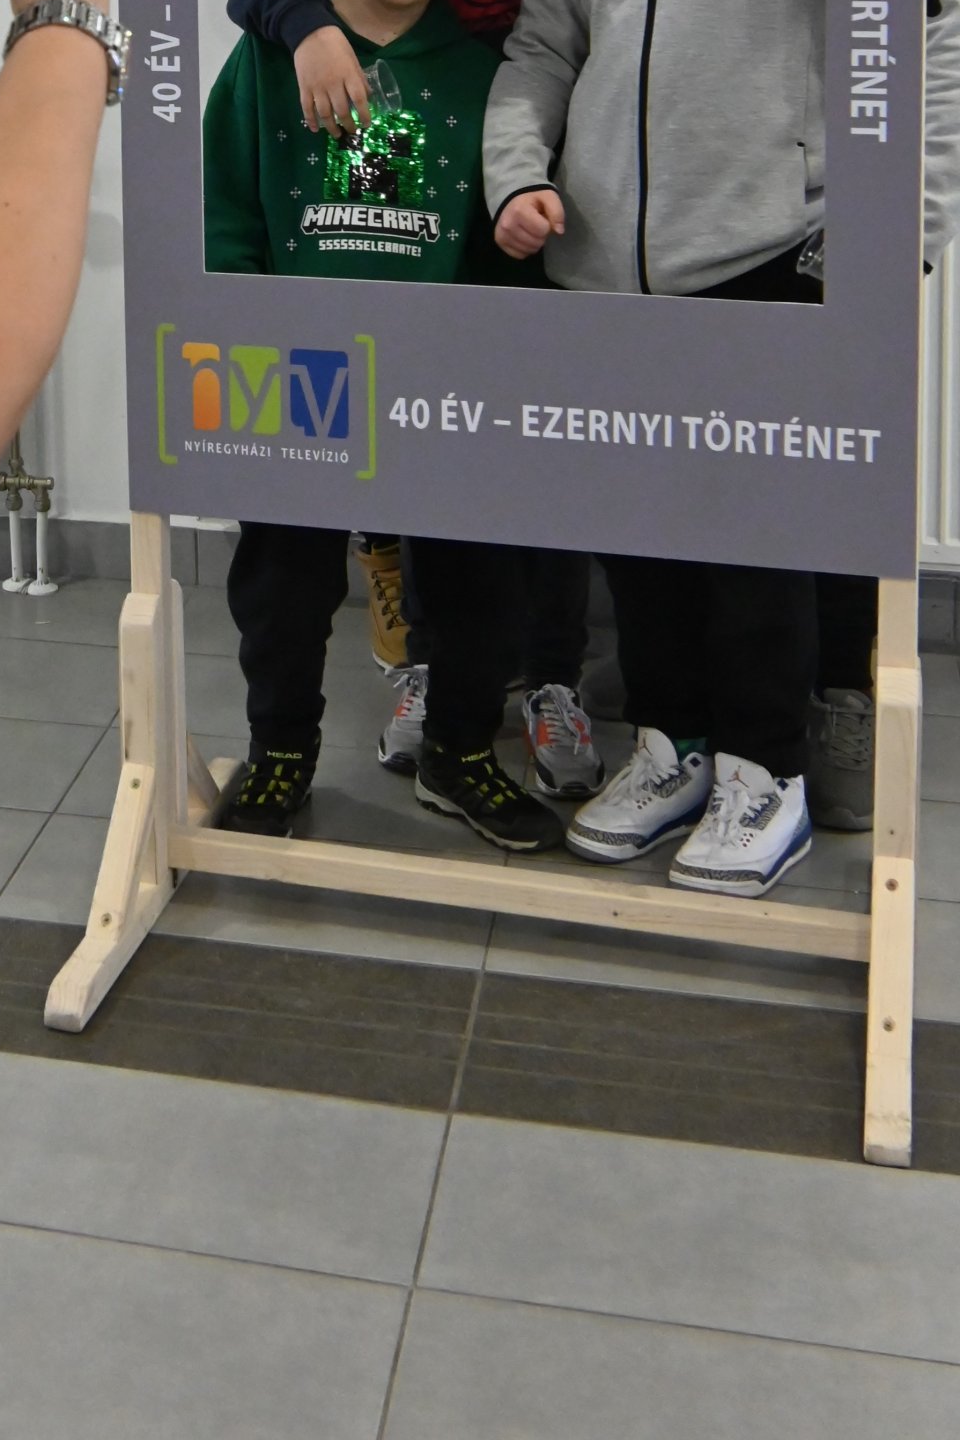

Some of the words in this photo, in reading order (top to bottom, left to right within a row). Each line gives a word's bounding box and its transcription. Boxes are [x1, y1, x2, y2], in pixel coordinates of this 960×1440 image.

[144, 30, 181, 72] ÉV
[152, 82, 182, 123] 40
[301, 204, 440, 242] MINECRAFT
[389, 397, 430, 430] 40
[441, 392, 484, 433] ÉV
[522, 404, 672, 448] EZERNYI
[681, 410, 881, 463] TÖRTÉNET
[184, 439, 271, 458] NYÍREGYHÁZI
[281, 446, 349, 464] TELEVÍZIÓ
[266, 749, 303, 759] HEAD
